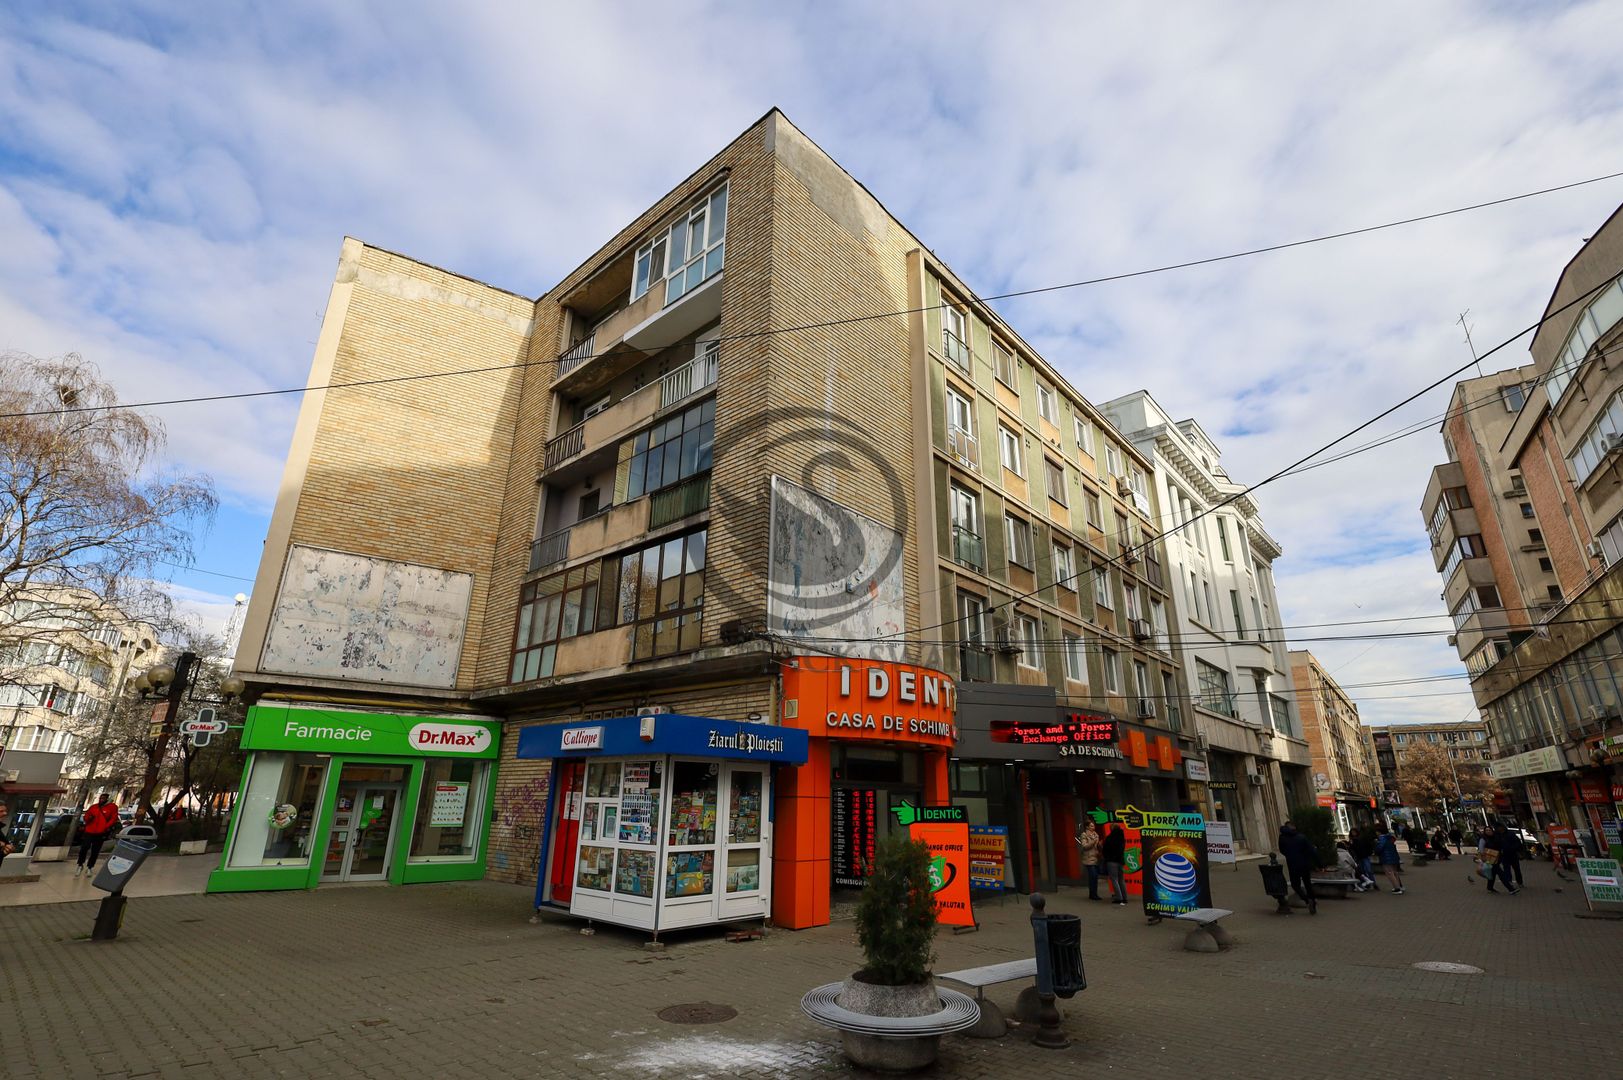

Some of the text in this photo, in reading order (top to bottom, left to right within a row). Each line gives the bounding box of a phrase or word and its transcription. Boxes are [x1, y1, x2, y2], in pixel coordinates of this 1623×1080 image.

[826, 711, 950, 737] CASA DE SCHIMB
[1080, 722, 1113, 732] Forex
[284, 721, 476, 746] Farmacie Dr.Max
[563, 731, 598, 747] Calliope
[708, 729, 738, 748] Ziarul
[1023, 730, 1111, 744] Exchange Office
[1078, 745, 1092, 756] DE
[1209, 782, 1236, 790] AMANET
[1152, 815, 1179, 827] FOREX
[1181, 816, 1202, 826] AMD
[1141, 829, 1177, 838] EXCHANGE
[1178, 830, 1203, 839] OFFICE
[1579, 860, 1617, 870] SECOND
[1146, 902, 1175, 912] SCHIMB
